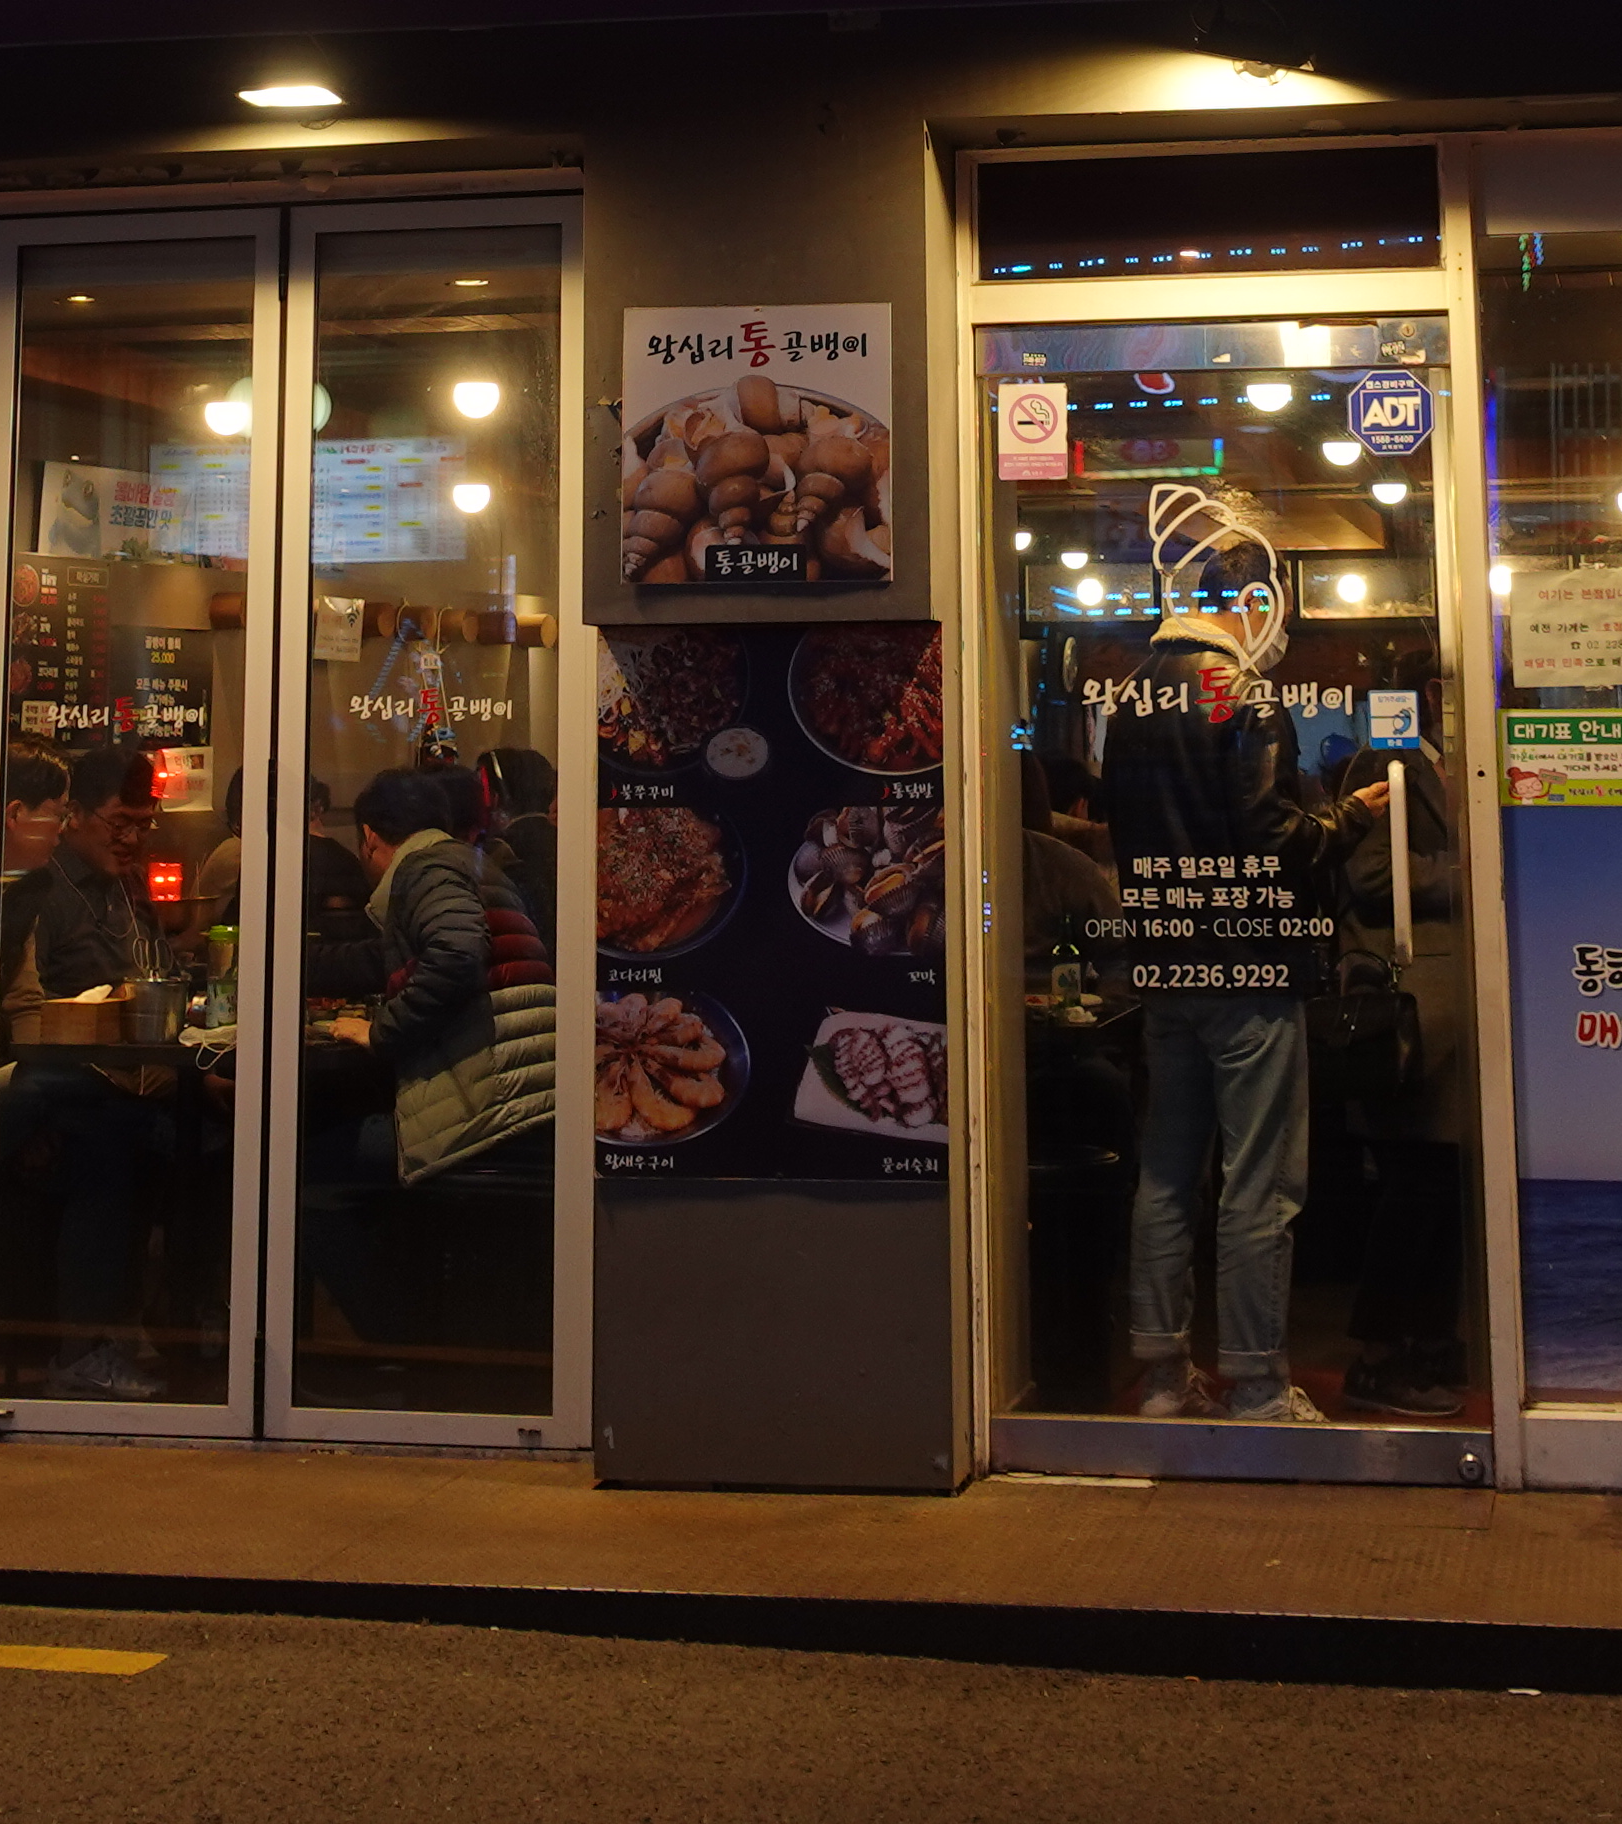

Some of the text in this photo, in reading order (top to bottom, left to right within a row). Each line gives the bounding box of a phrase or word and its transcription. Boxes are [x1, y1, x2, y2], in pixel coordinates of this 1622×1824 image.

[1362, 395, 1421, 428] ADT
[715, 550, 798, 575] 통골뱅이
[1538, 588, 1574, 600] 여기는
[1529, 623, 1551, 634] 예전
[1557, 622, 1590, 633] 가게는
[1587, 640, 1600, 649] 02
[1524, 657, 1556, 669] 배달의
[1561, 657, 1606, 668] 민족으로
[1513, 720, 1622, 743] 대기표 안내
[892, 783, 935, 800] 통닭발
[1132, 856, 1281, 879] 매주 일요일 휴무
[1122, 887, 1295, 909] 모든 메뉴 포장 가능
[1085, 920, 1137, 939] OPEN
[1142, 919, 1194, 938] 16:00
[1213, 919, 1273, 939] CLOSE
[1279, 918, 1334, 937] 02:00
[607, 968, 663, 985] 코다리찜
[1132, 964, 1290, 990] 02.2236.9292
[604, 1153, 675, 1171] 왕새우구이
[882, 1156, 939, 1174] 문어숙회
